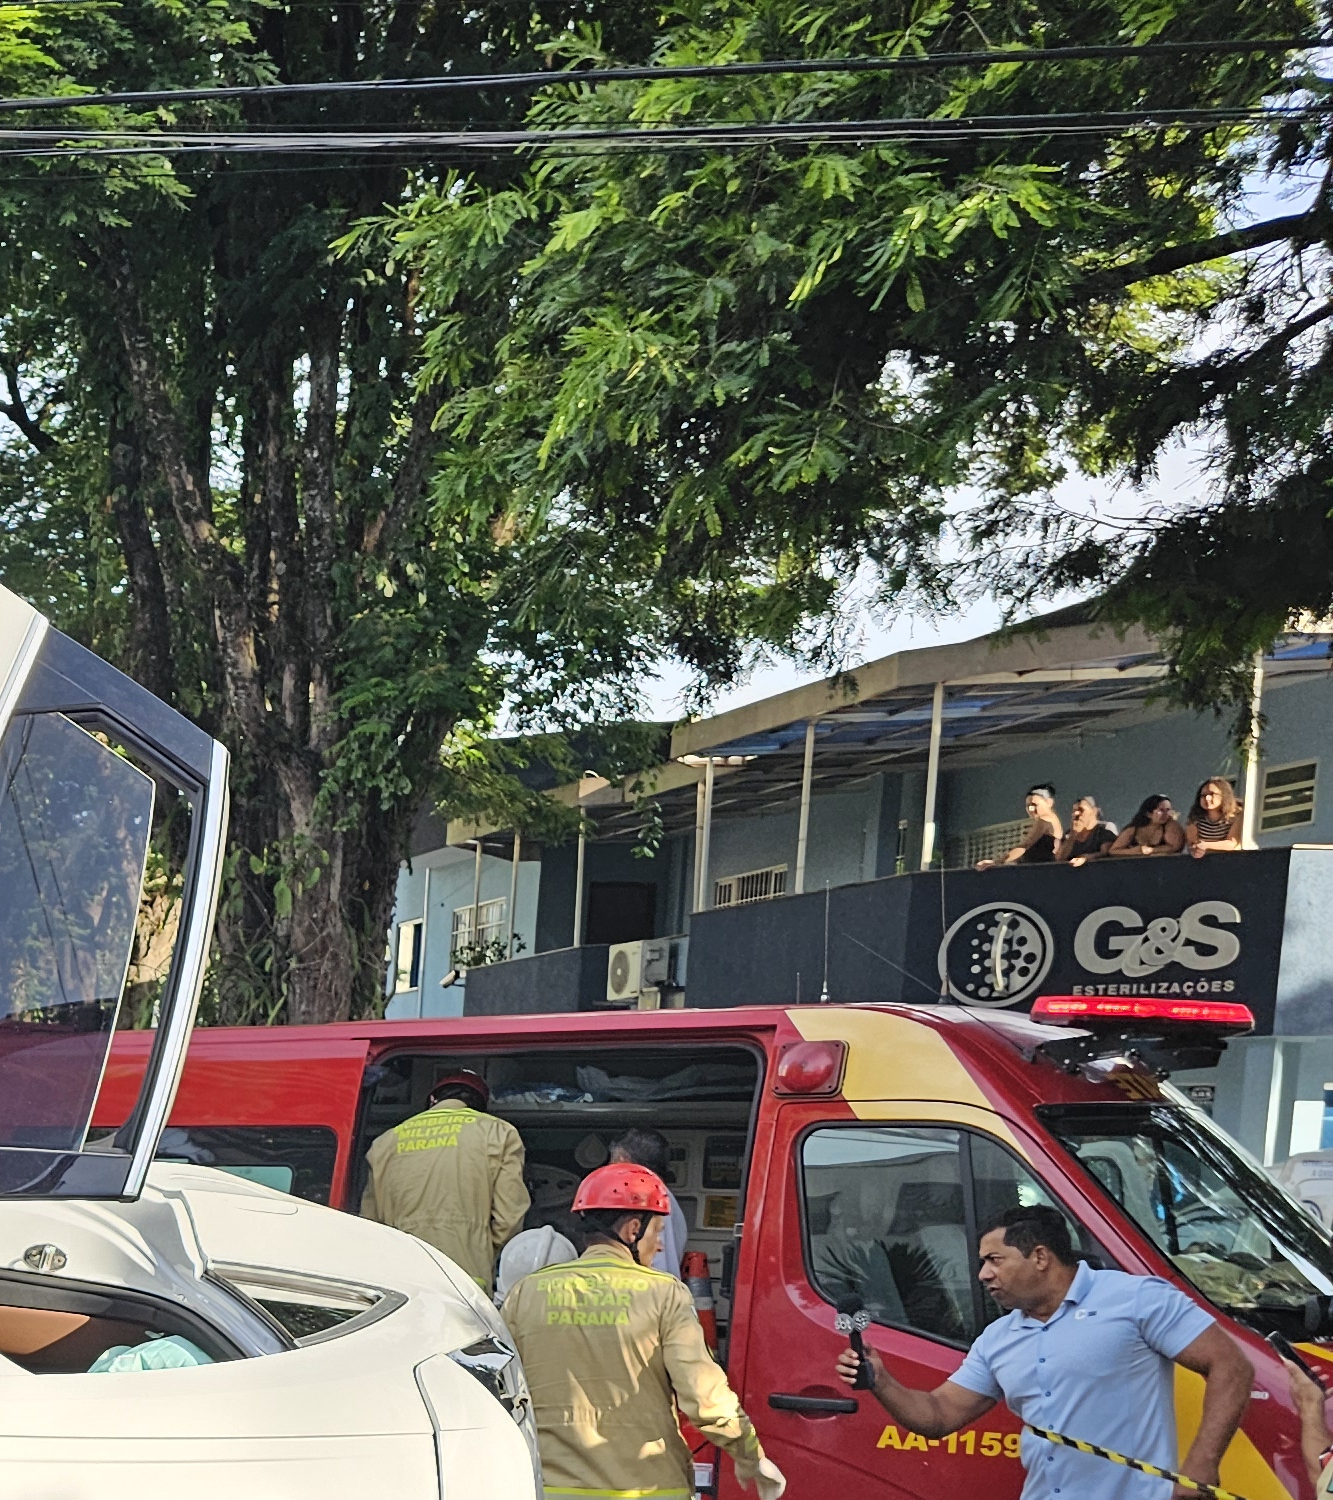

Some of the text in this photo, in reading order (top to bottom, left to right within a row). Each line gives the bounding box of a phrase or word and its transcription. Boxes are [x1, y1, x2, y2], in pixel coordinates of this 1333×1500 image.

[1074, 900, 1241, 978] G&S
[1072, 978, 1235, 997] ESTERILIZAÇÕES
[398, 1123, 462, 1139] MILITAR
[546, 1291, 632, 1309] MILITAR
[546, 1308, 630, 1325] PARANÁ
[876, 1424, 1021, 1458] AA-1159
